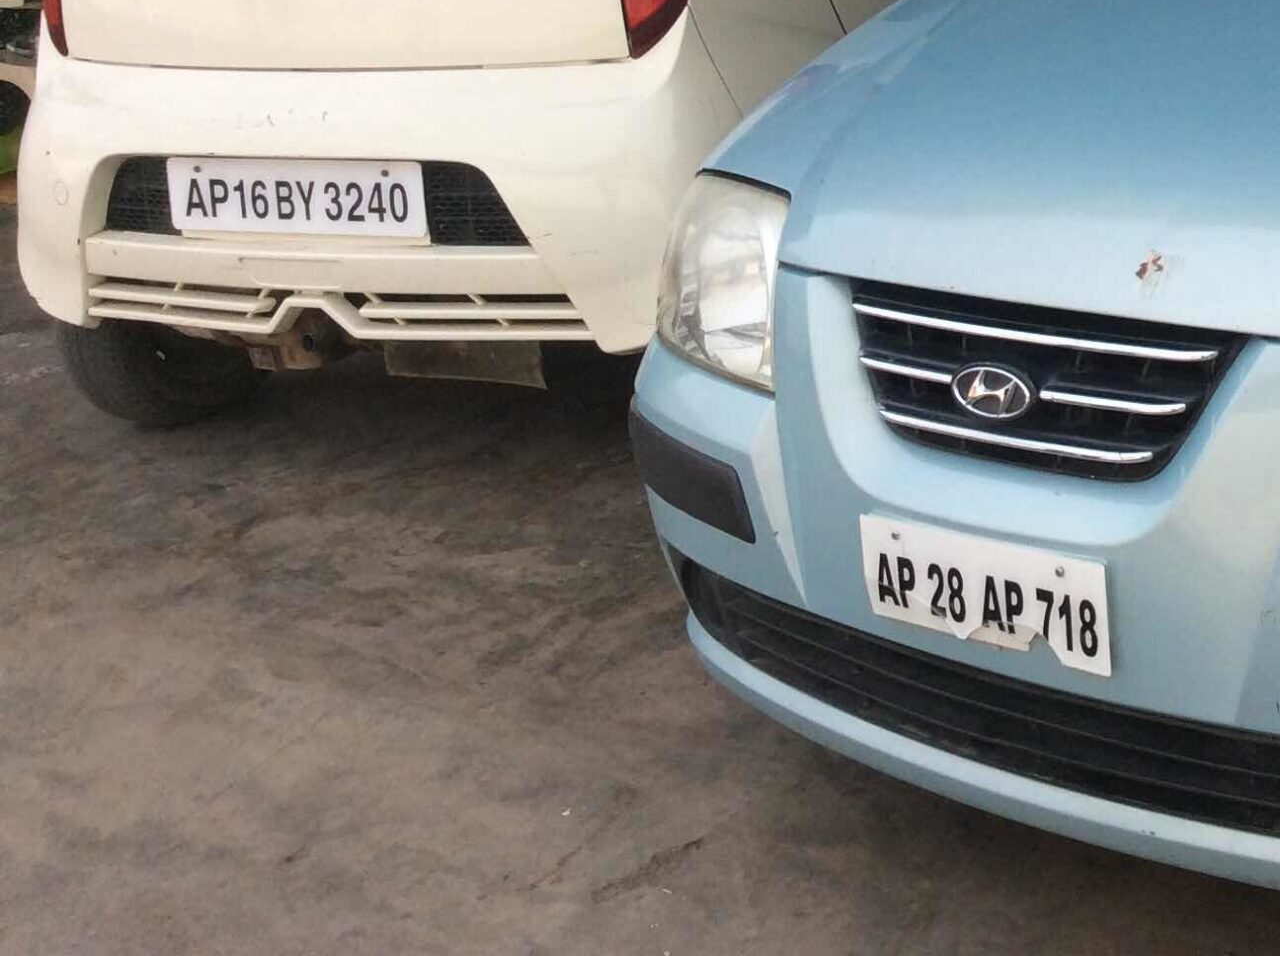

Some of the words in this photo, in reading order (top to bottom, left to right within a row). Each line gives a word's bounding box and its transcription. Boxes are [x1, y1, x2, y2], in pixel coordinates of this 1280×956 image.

[878, 552, 916, 609] AP
[927, 563, 967, 623] 28
[981, 575, 1024, 635] AP
[1035, 587, 1099, 658] 718
